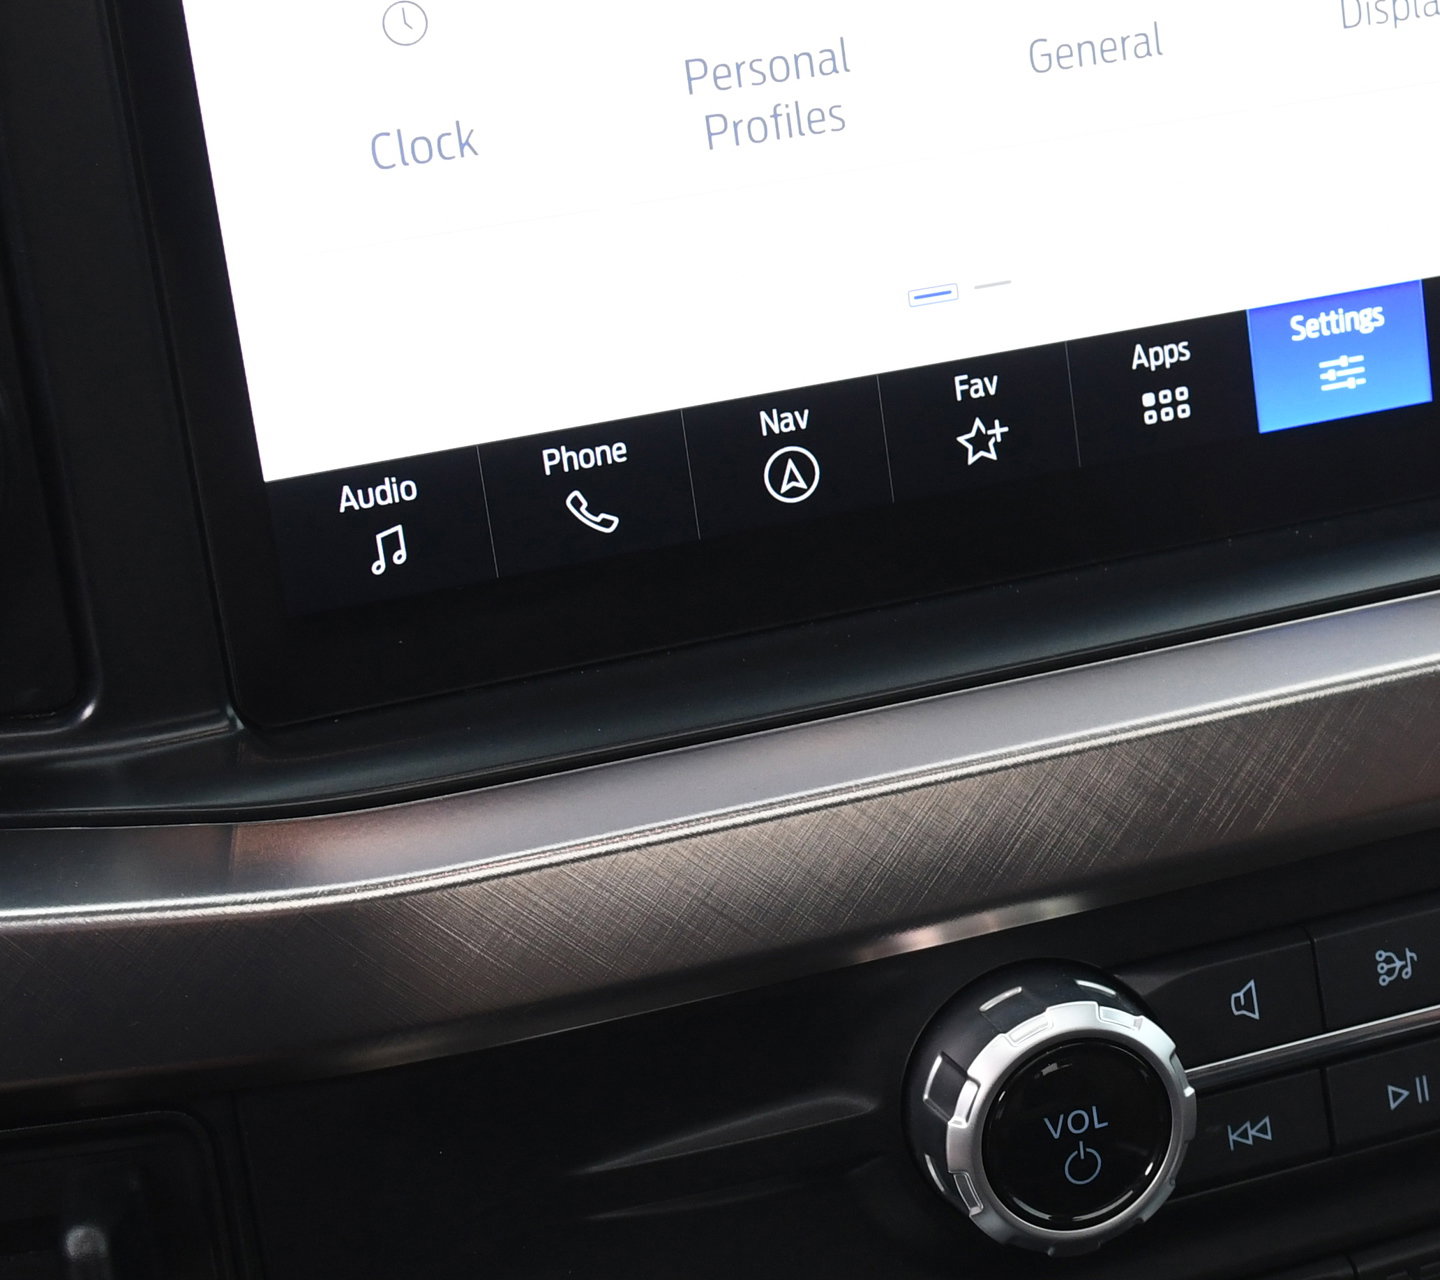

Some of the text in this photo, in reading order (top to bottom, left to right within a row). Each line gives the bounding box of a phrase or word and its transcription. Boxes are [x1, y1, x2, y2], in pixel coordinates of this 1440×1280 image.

[685, 37, 850, 95] Personal
[1030, 21, 1163, 73] General
[371, 120, 479, 169] Clock
[705, 101, 845, 150] Profiles
[1290, 302, 1385, 342] Settings
[1132, 342, 1190, 371] Apps
[955, 375, 997, 401] Fav
[760, 409, 808, 436] Nav
[542, 437, 628, 475] Phone
[338, 474, 418, 513] Audio
[1044, 1104, 1109, 1141] VOL
